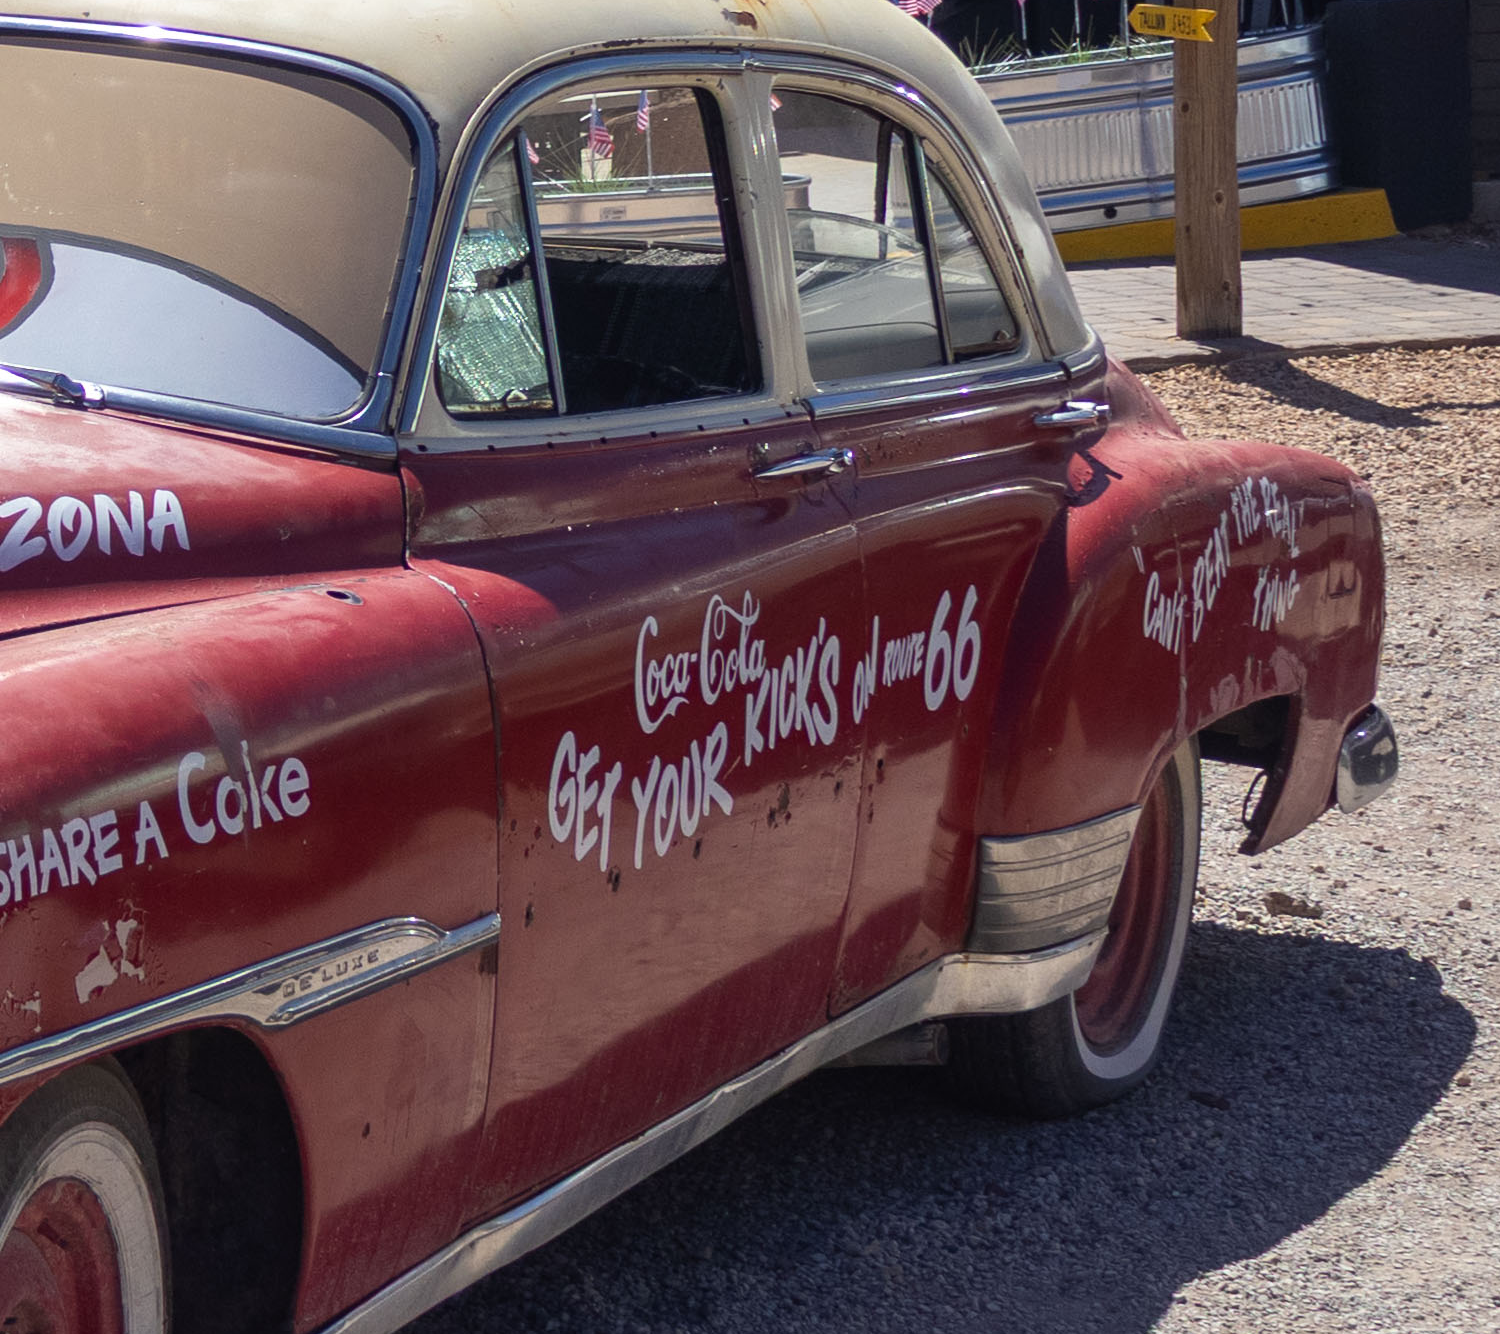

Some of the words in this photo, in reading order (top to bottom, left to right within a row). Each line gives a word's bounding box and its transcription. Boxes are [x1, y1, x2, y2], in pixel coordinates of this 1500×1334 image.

[1192, 510, 1231, 643] BEAT
[1230, 476, 1261, 546] THE
[1252, 564, 1301, 632] THING
[548, 731, 623, 872] GET
[631, 721, 734, 869] YOUR
[744, 617, 840, 767] KICK'S
[852, 615, 879, 724] ON
[883, 630, 926, 687] ROUTE
[924, 584, 982, 711] 66
[634, 589, 767, 735] Coca-Cola
[135, 800, 169, 865] A
[177, 739, 311, 844] Coke
